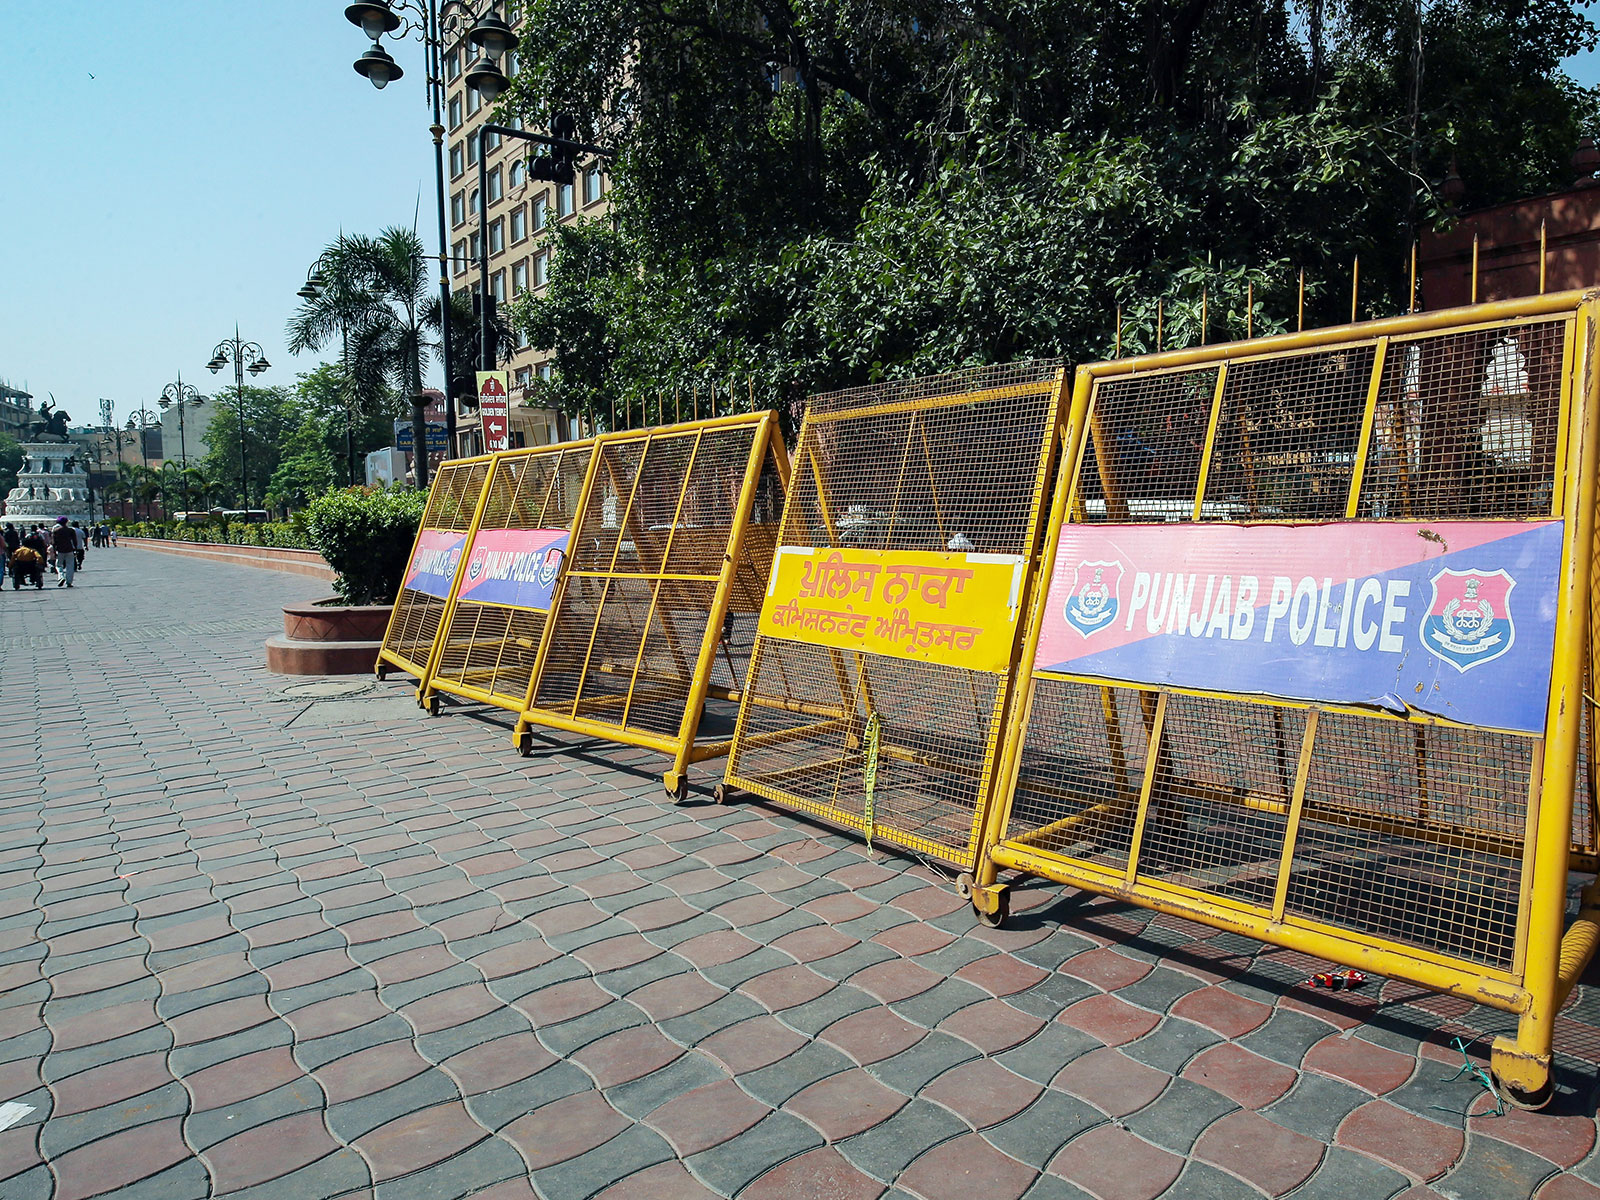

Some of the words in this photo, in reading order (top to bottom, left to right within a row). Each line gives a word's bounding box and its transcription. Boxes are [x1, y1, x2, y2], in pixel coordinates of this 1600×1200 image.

[482, 550, 513, 581] PUNJAB
[508, 551, 542, 583] POLICE
[799, 551, 882, 602] ਪੁਲਿਸ
[882, 564, 974, 609] ਨਾਕਾ
[1125, 571, 1259, 641] PUNJAB
[1263, 575, 1411, 653] POLICE
